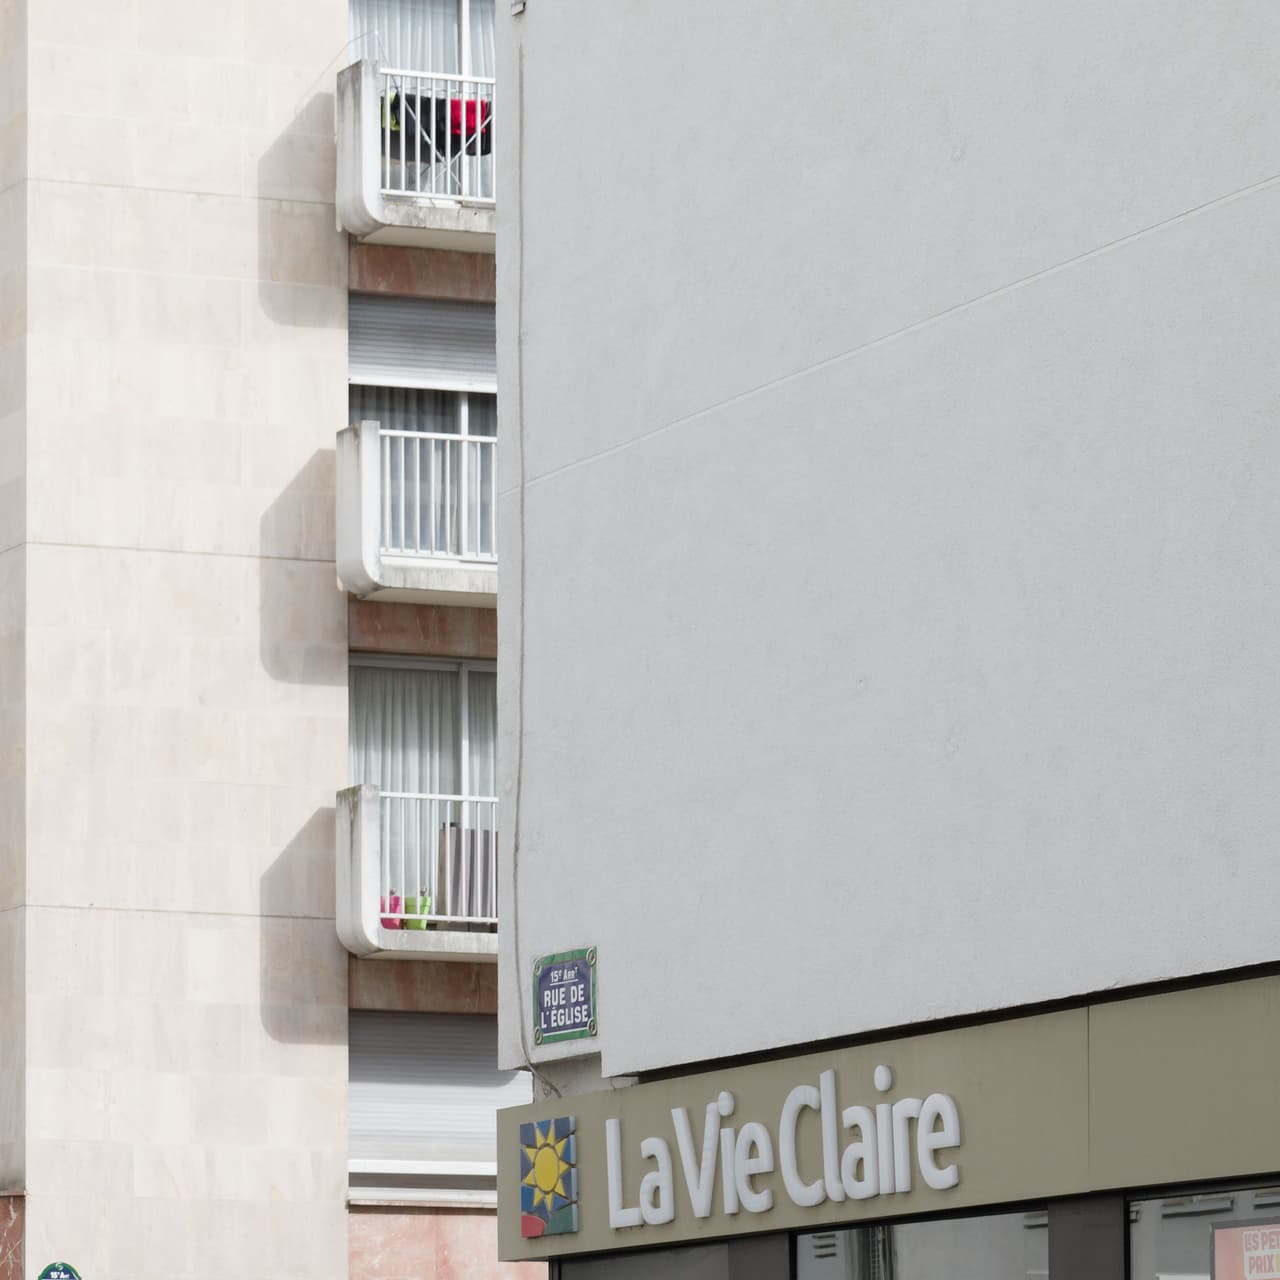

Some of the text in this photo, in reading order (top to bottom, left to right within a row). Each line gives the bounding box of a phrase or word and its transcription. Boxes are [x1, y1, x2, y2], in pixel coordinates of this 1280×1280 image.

[544, 984, 585, 1007] RUE DE
[541, 1005, 589, 1029] L'ÉGLISE
[606, 1064, 961, 1229] La Vie Claire
[1248, 1254, 1275, 1274] PRIX
